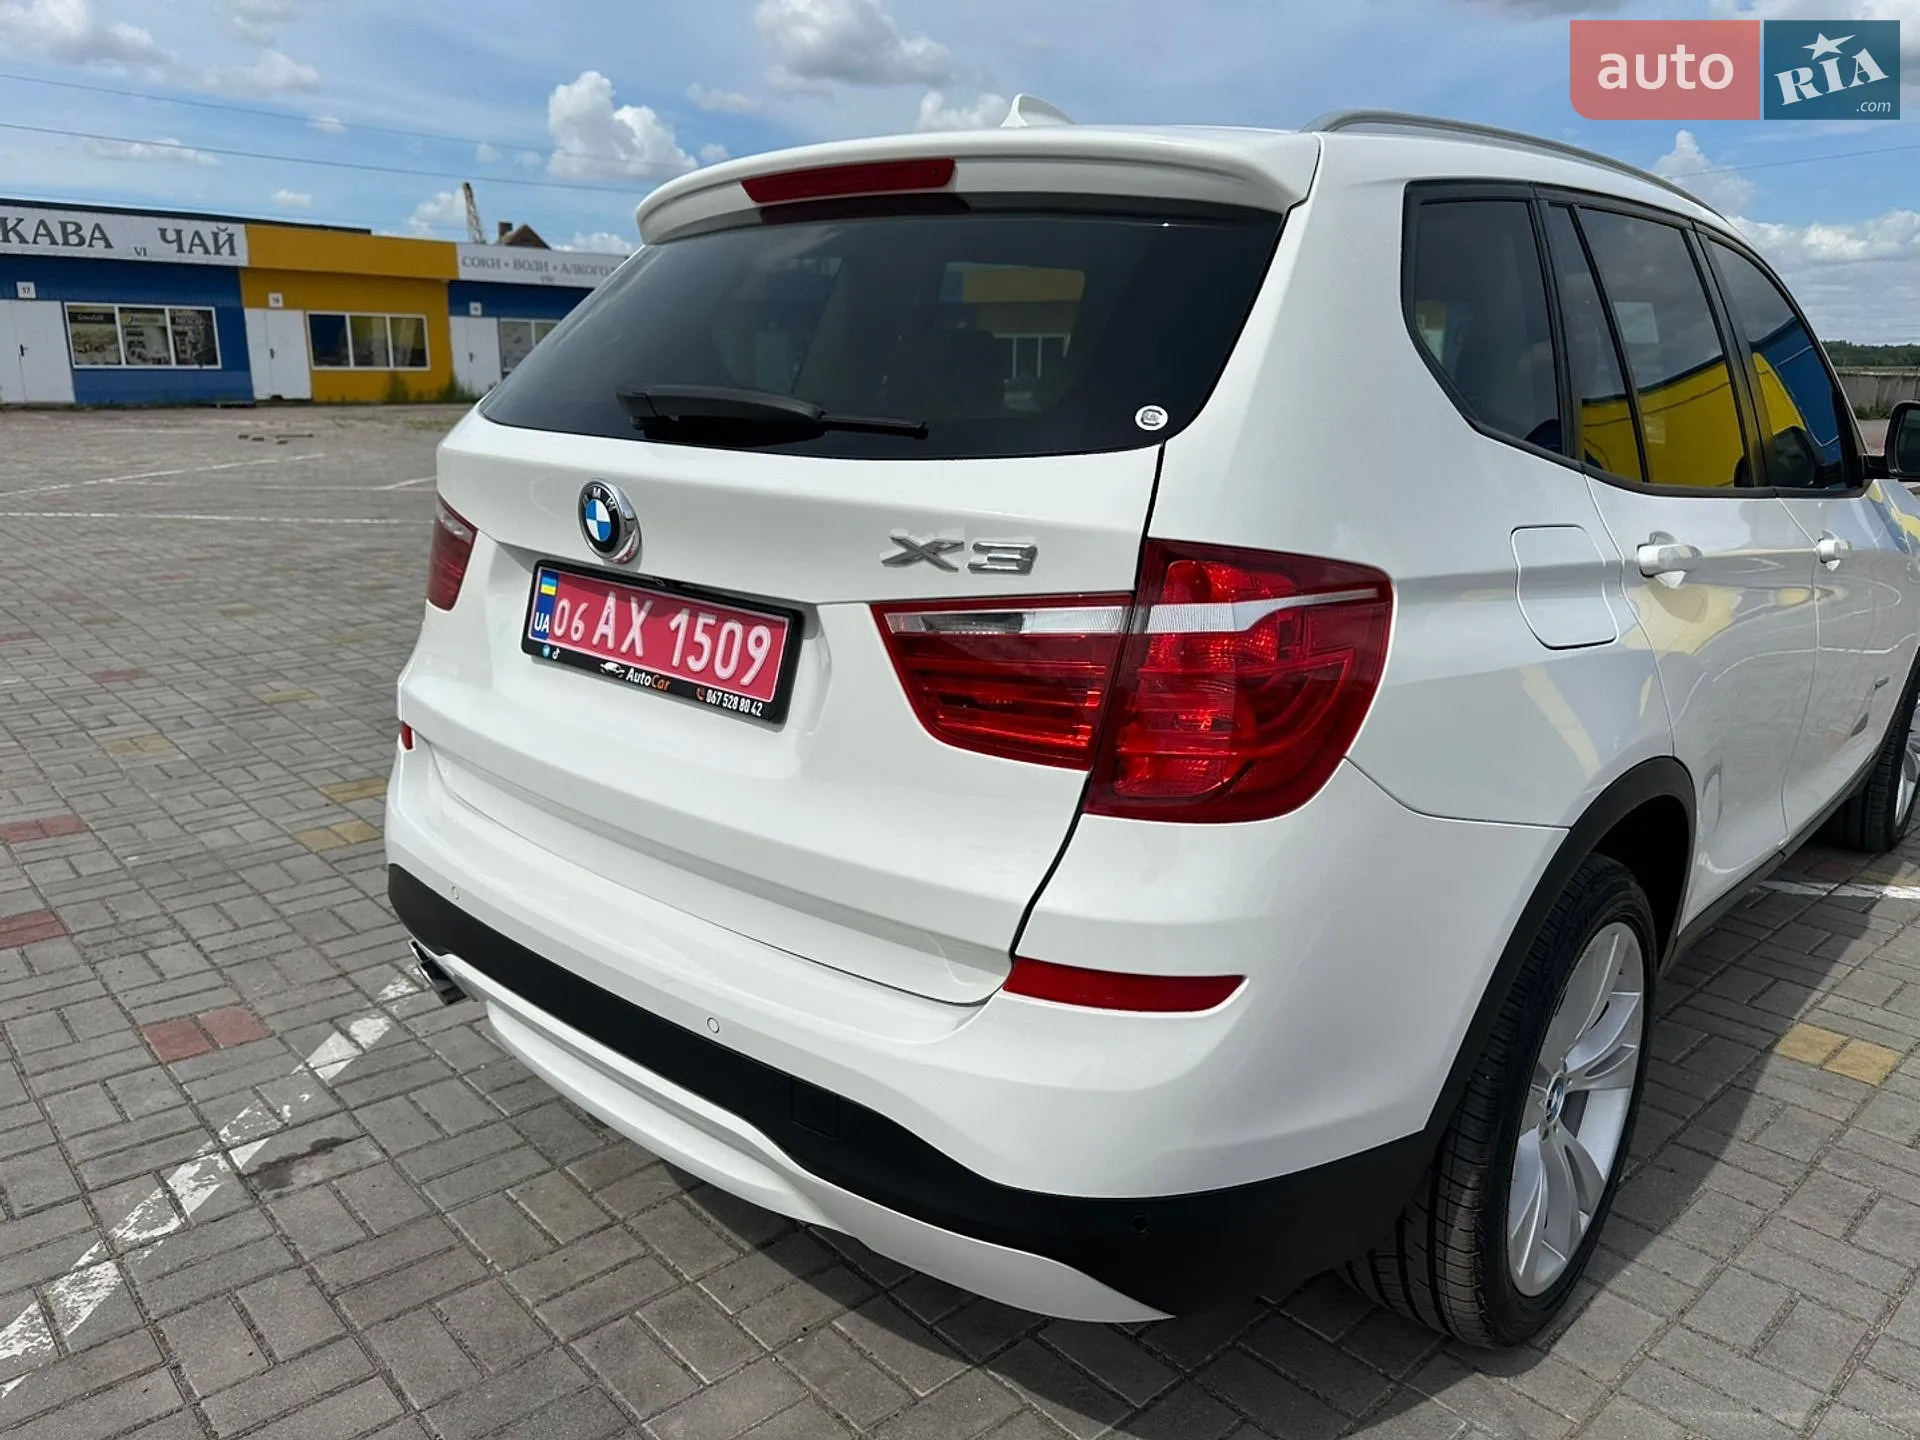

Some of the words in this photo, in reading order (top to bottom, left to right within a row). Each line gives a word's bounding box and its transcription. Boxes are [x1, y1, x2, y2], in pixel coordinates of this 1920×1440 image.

[0, 216, 114, 249] КАВА
[157, 225, 238, 257] ЧАЙ
[461, 255, 501, 270] СОКИ
[512, 257, 549, 272] ВОДИ
[880, 535, 1038, 576] X3
[534, 611, 550, 633] UA
[553, 598, 589, 642] 06
[592, 591, 653, 657] AX
[669, 607, 772, 687] 1509
[626, 667, 671, 692] AutoCar
[705, 689, 722, 706] 067
[722, 693, 739, 711] 528
[738, 697, 751, 714] 80
[750, 701, 763, 717] 42
